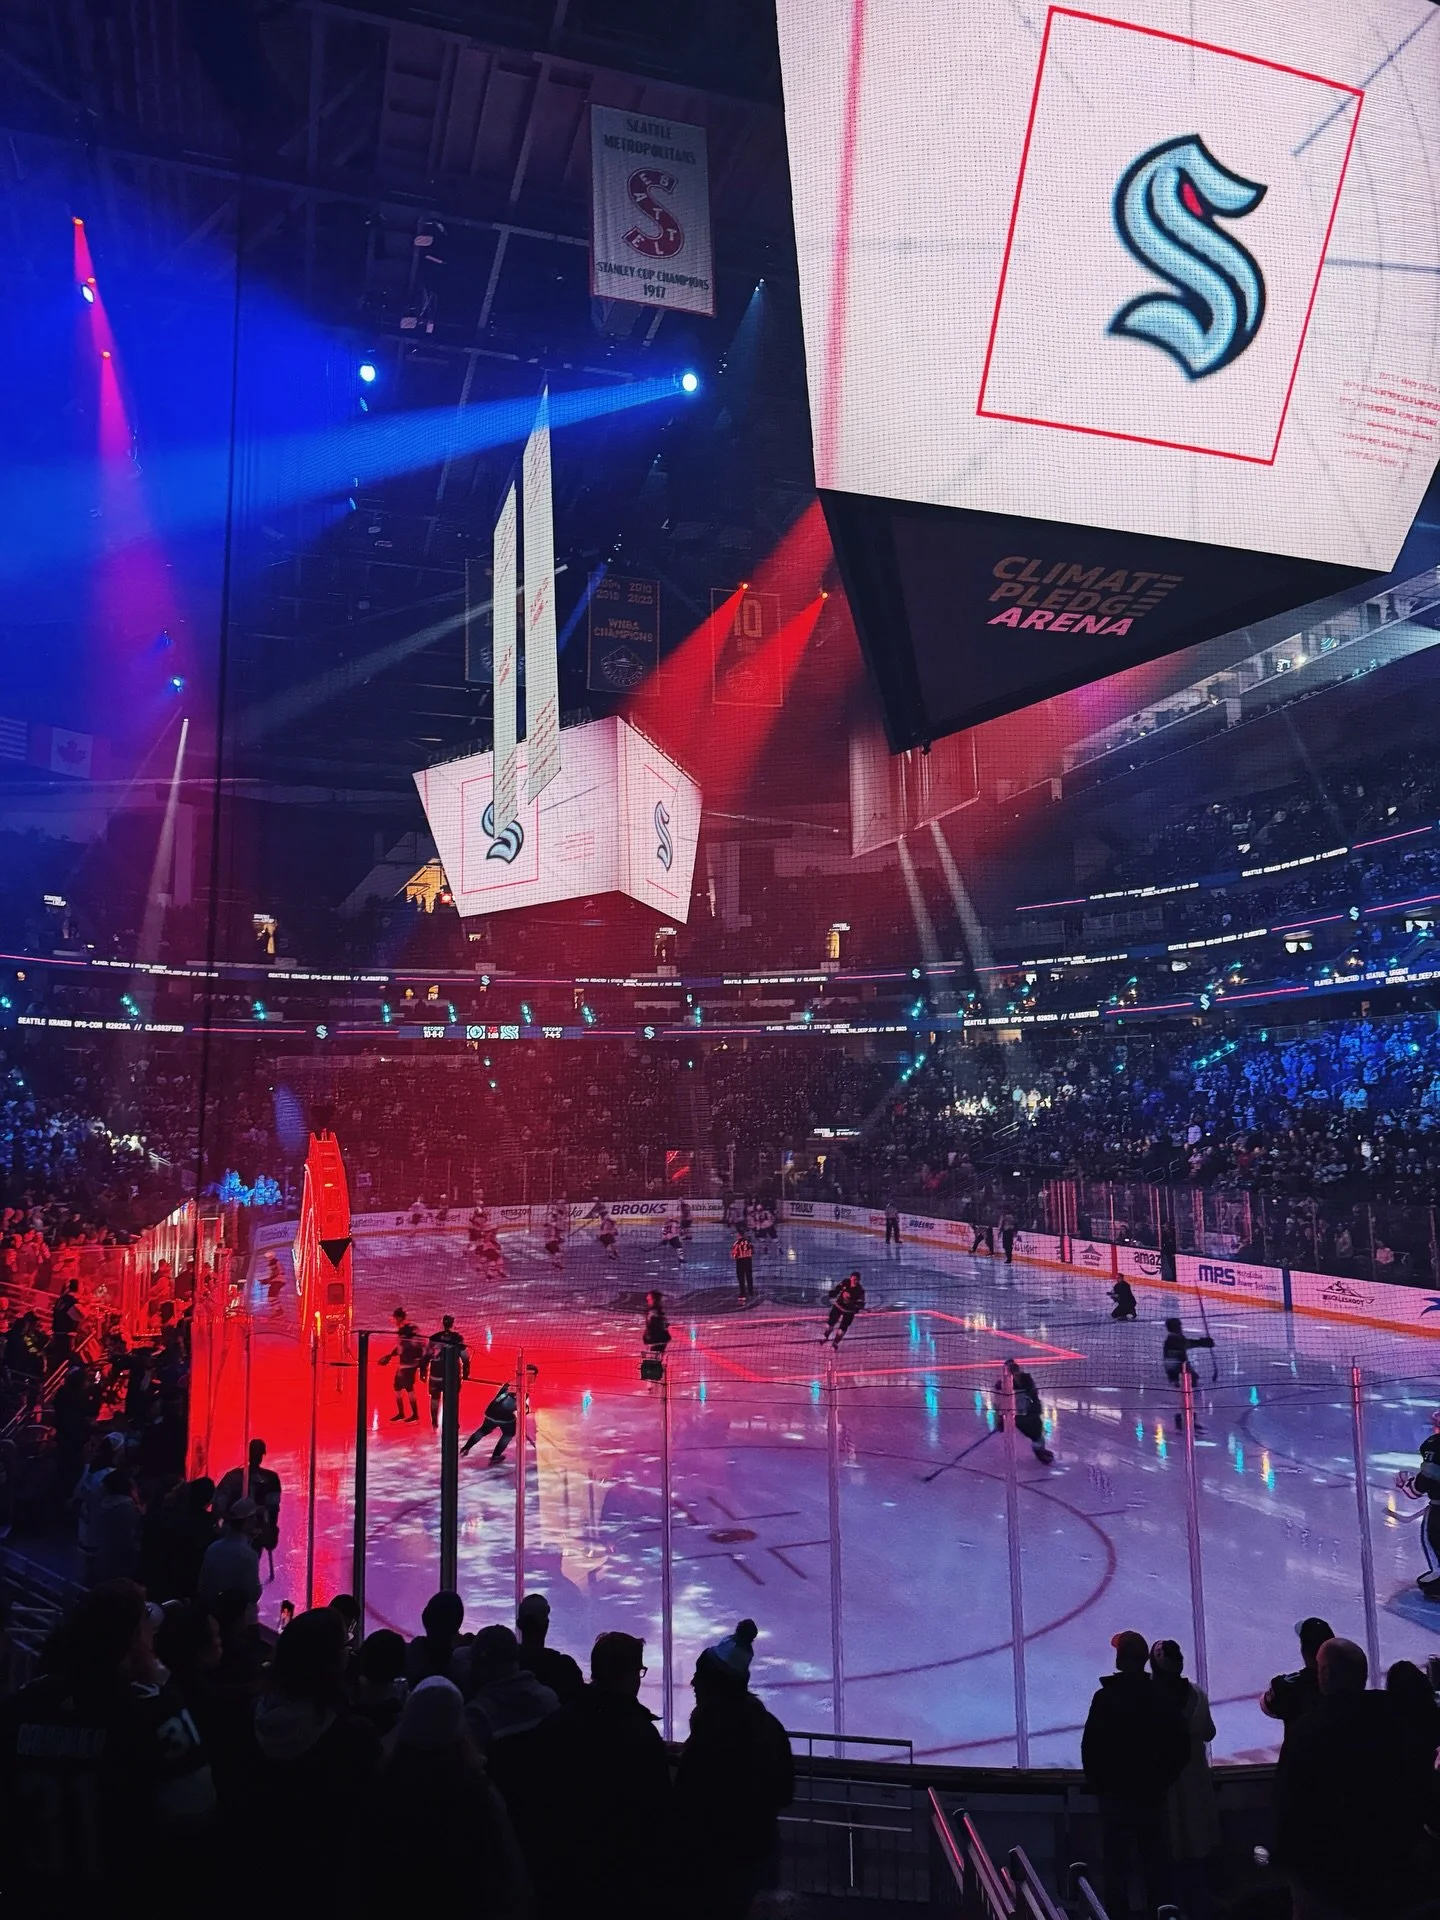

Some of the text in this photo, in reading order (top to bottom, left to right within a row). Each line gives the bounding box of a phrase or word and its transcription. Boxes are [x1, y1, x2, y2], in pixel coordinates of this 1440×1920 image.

[627, 118, 673, 140] SEATTLE
[603, 134, 696, 165] METROPOLITANS
[596, 261, 710, 291] STANLEY CUP CHAMPIONS
[642, 283, 666, 299] 1917
[608, 618, 640, 631] WNBA
[986, 607, 1135, 636] ARENA
[593, 627, 654, 642] CHAMPIONS
[18, 1017, 46, 1025] SEATTLE
[49, 1019, 72, 1027] KRAKEN
[611, 1203, 668, 1215] BROOKS
[1134, 1252, 1161, 1266] amaz
[1199, 1264, 1236, 1286] MPS
